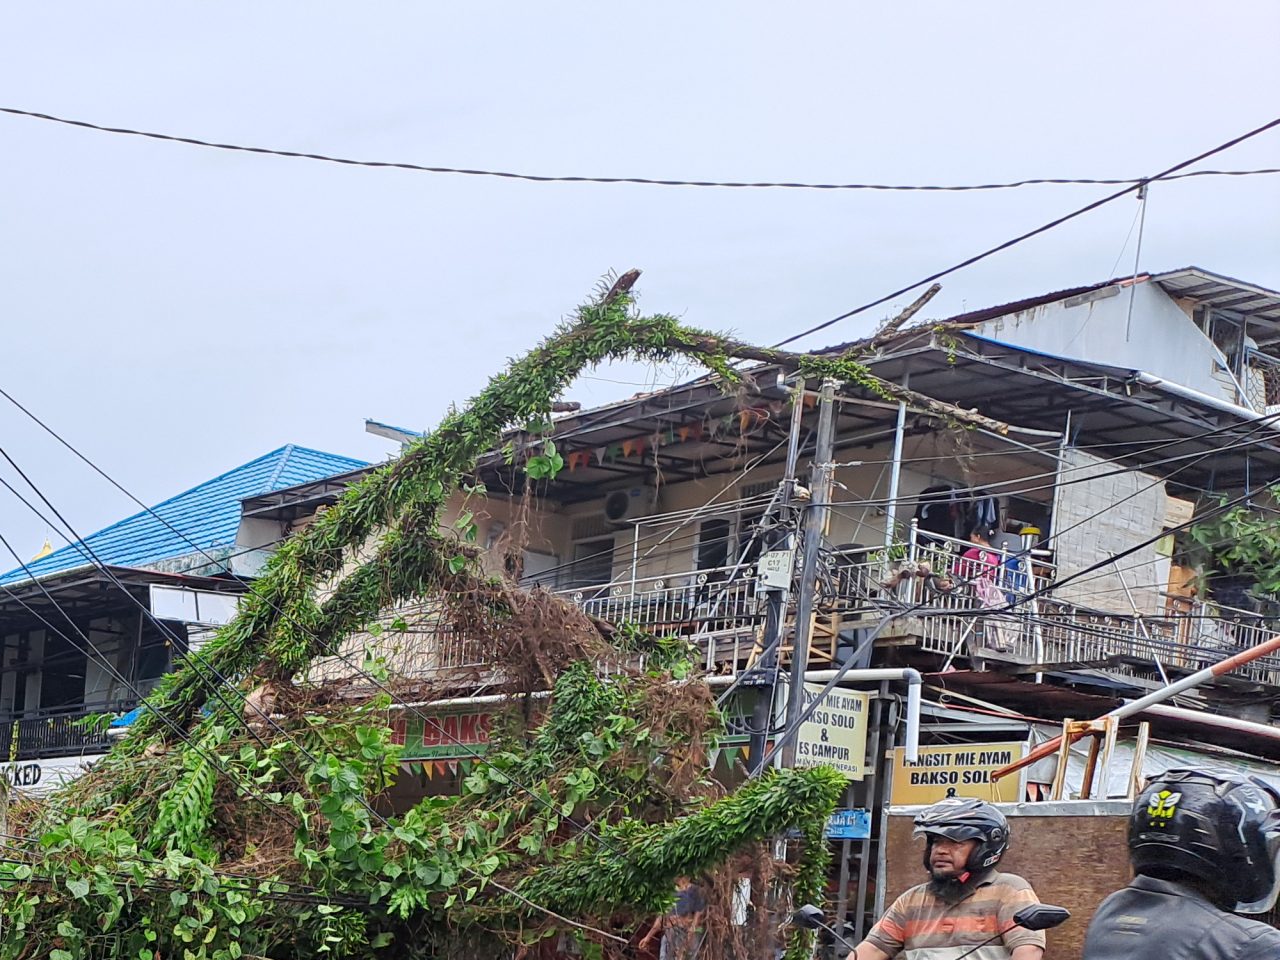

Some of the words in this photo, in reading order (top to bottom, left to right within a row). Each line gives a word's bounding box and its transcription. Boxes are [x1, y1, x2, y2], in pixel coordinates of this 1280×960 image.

[825, 694, 841, 709] MIE
[841, 696, 863, 712] AYAM
[831, 713, 856, 729] SOLO
[820, 728, 830, 742] &
[798, 741, 810, 756] ES
[811, 743, 851, 761] CAMPUR
[954, 751, 977, 766] MIE
[978, 751, 1011, 765] AYAM
[910, 771, 959, 785] BAKSO
